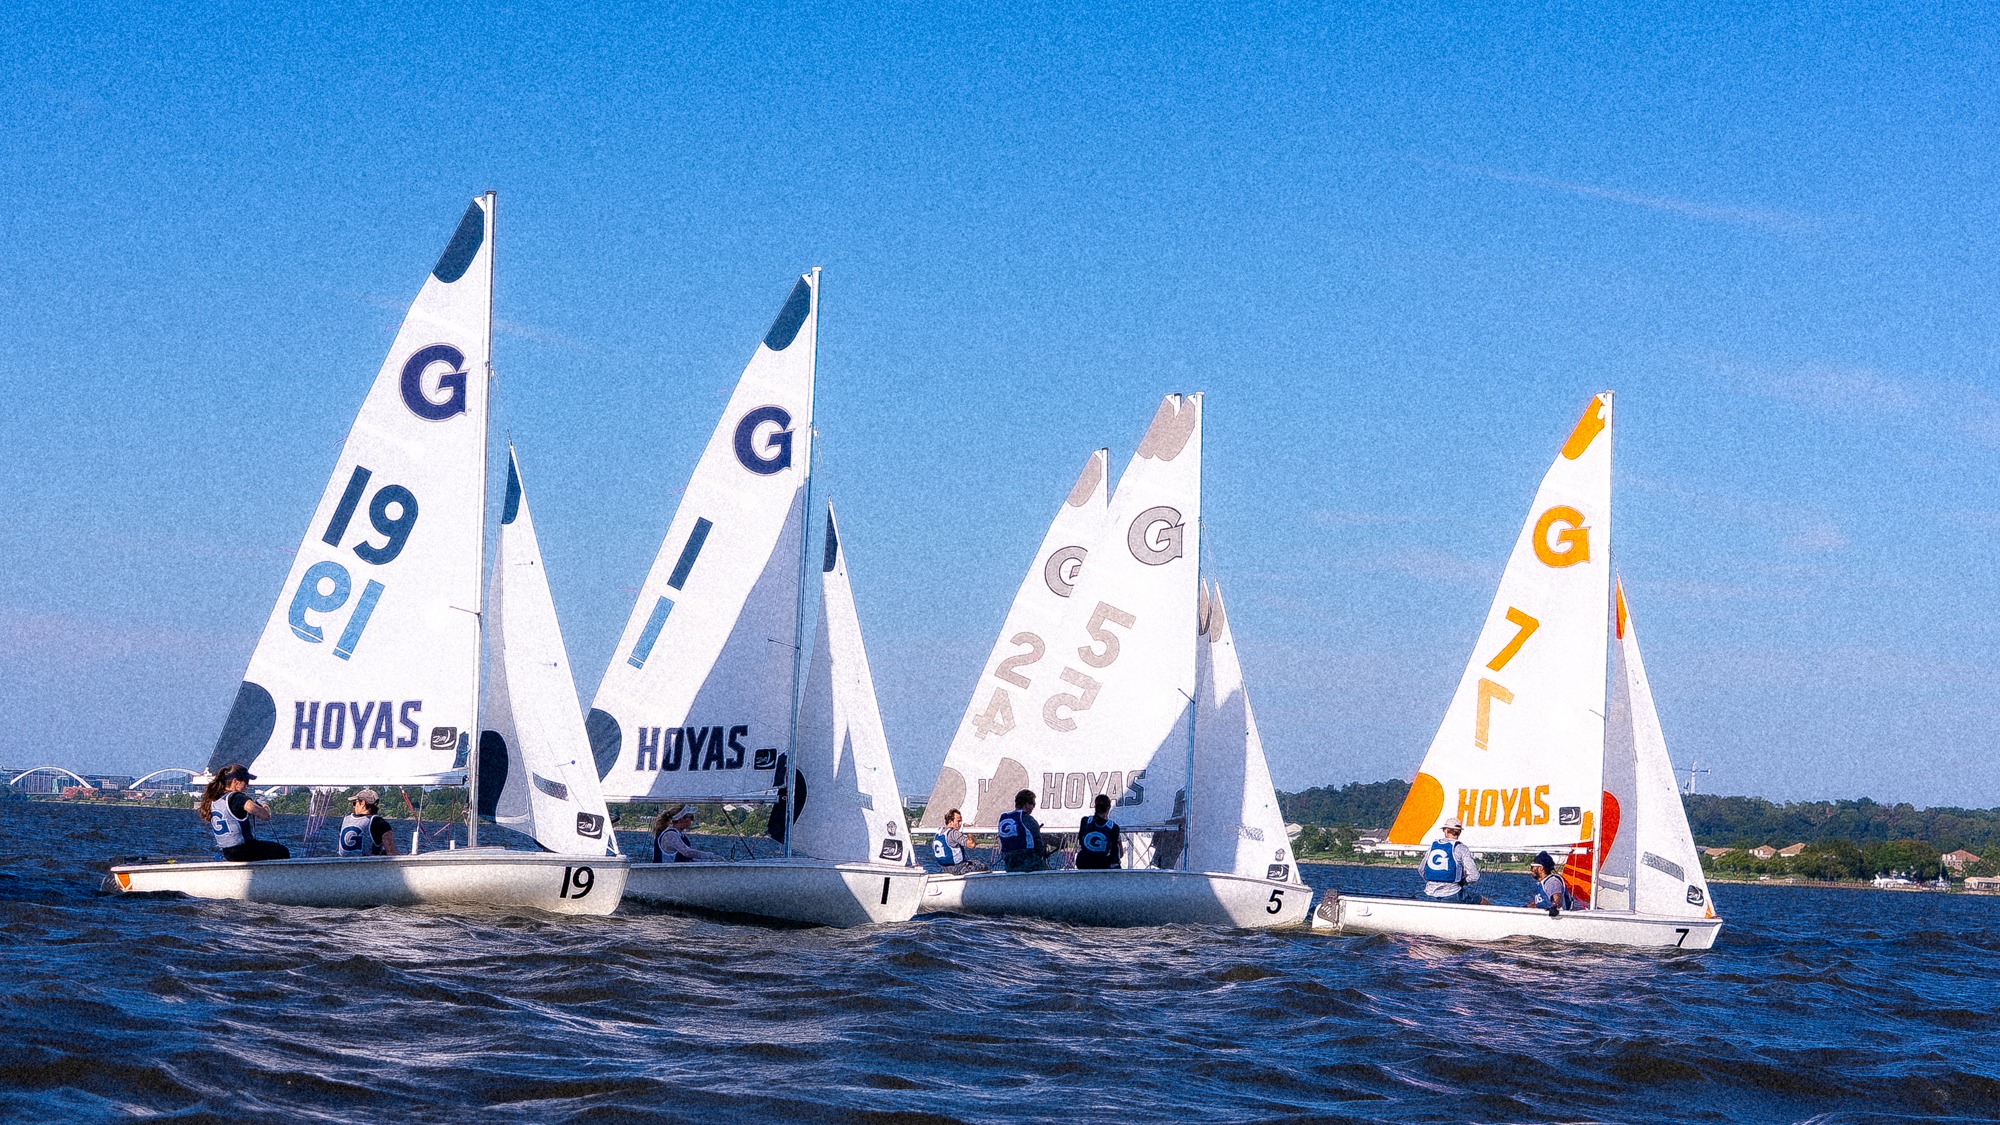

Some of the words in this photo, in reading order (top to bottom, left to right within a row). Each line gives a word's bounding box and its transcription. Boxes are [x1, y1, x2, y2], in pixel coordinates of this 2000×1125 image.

[400, 342, 470, 421] G
[733, 405, 796, 475] G
[322, 465, 419, 565] 19
[1127, 506, 1185, 566] G
[1533, 505, 1591, 568] G
[667, 517, 713, 591] 1
[1044, 545, 1088, 598] G
[1077, 601, 1136, 668] 5
[1486, 606, 1539, 672] 7
[995, 632, 1045, 690] 2
[291, 701, 423, 750] HOYAS
[635, 724, 749, 772] HOYAS
[1040, 770, 1147, 810] HOYAS
[1457, 785, 1550, 827] HOYAS
[211, 810, 231, 836] G
[341, 825, 364, 851] G
[999, 818, 1019, 838] G
[1083, 831, 1107, 852] G
[933, 840, 946, 858] G
[1427, 849, 1450, 871] G
[560, 866, 595, 899] 19
[881, 877, 891, 905] 1
[1266, 889, 1284, 914] 5
[1675, 928, 1690, 947] 7
